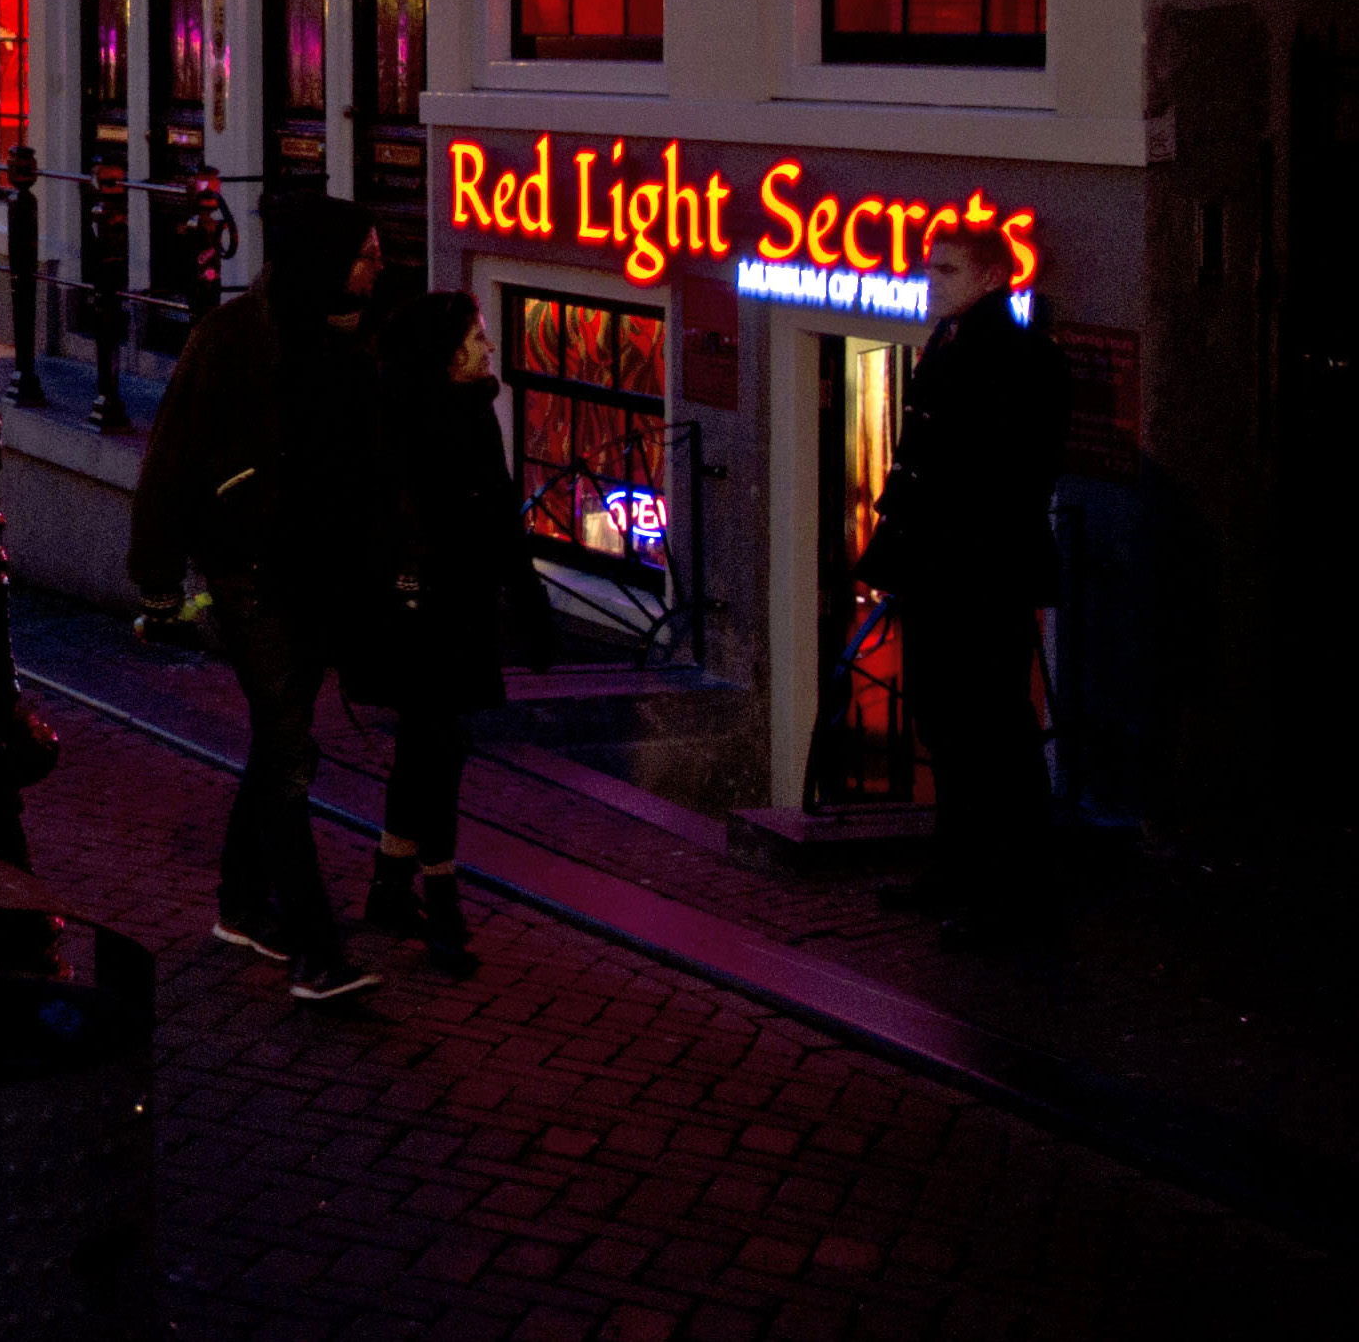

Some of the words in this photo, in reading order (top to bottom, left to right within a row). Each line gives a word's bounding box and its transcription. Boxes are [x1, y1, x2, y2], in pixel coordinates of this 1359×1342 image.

[448, 133, 553, 236] Red
[573, 138, 732, 285] Light
[737, 260, 828, 301] MUSEUM
[828, 273, 860, 307] OF
